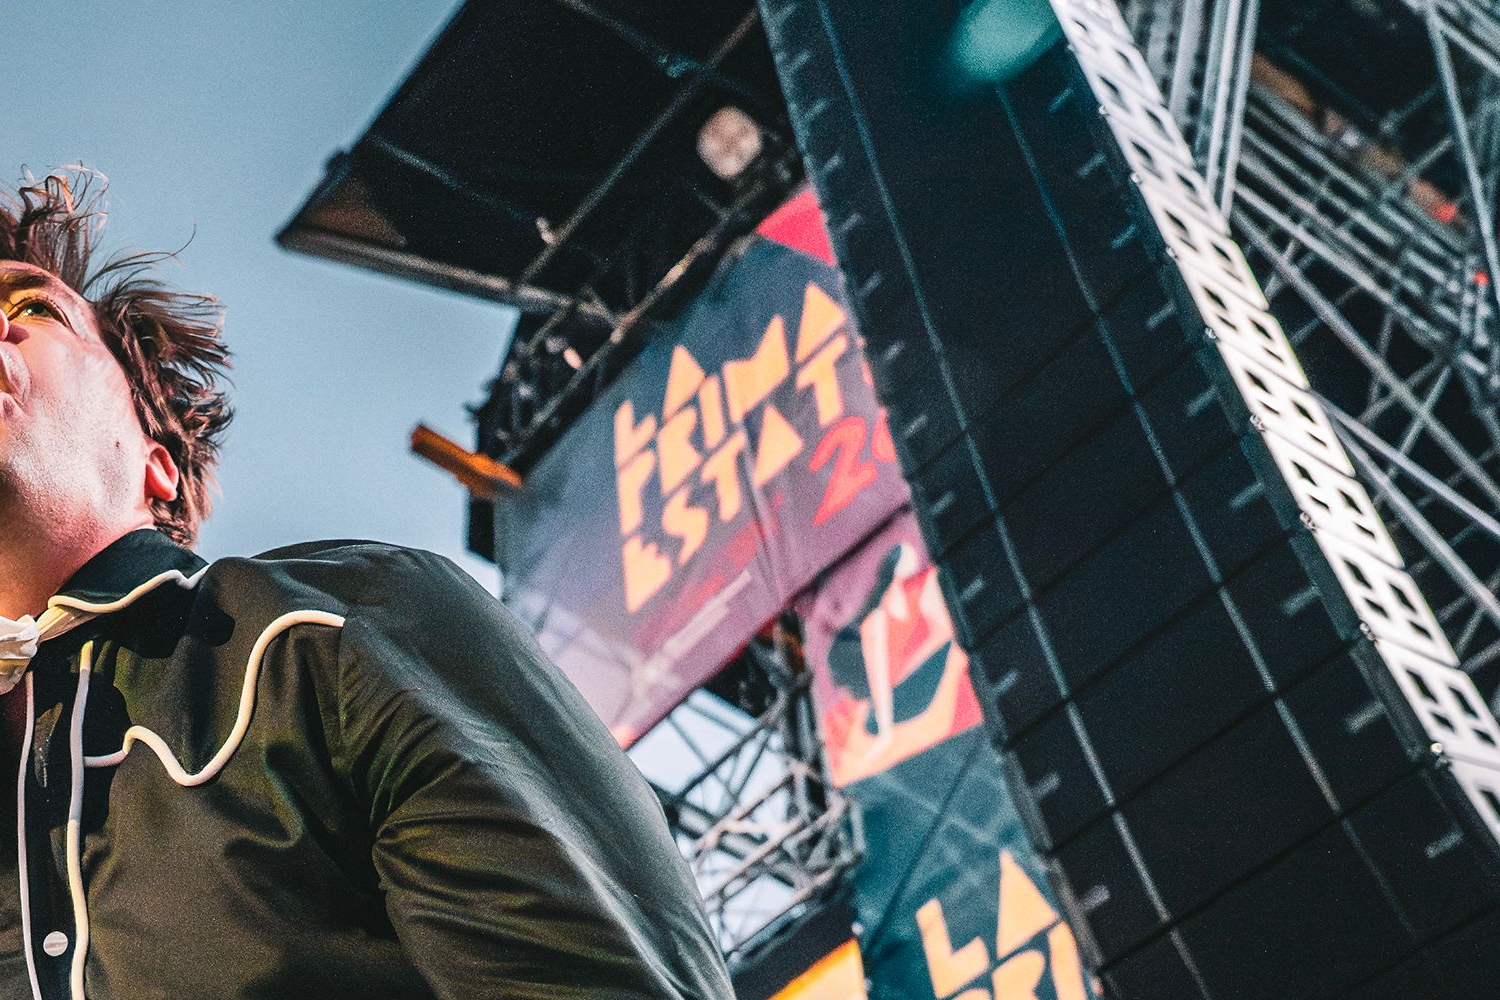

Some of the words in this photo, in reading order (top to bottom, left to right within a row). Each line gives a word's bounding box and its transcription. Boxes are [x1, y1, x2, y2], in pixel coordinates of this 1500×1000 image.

[614, 344, 706, 468] LA
[617, 282, 848, 537] PRIMA
[622, 332, 874, 613] ESTAT
[915, 849, 1059, 1000] LA
